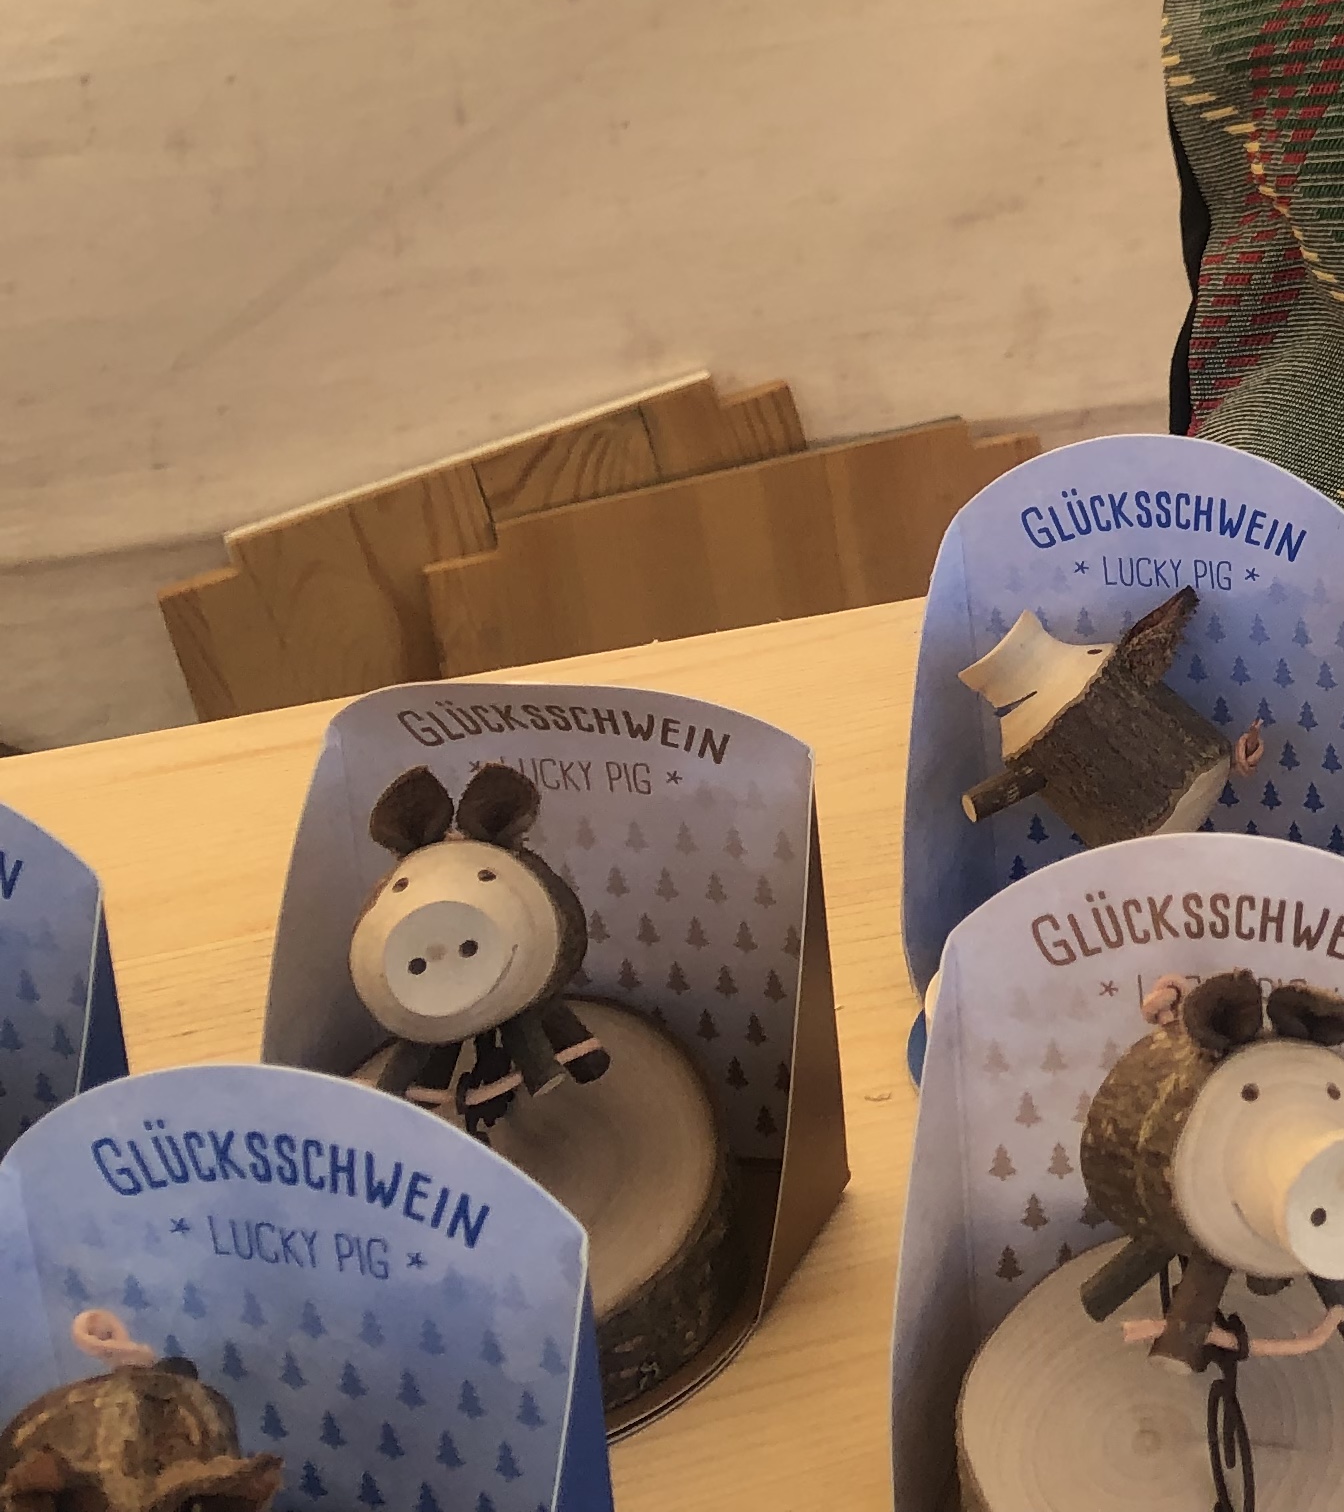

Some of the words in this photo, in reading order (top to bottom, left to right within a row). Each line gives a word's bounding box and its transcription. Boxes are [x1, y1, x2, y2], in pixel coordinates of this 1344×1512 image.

[1019, 487, 1308, 563] GLÜCKSSCHWEIN
[1102, 556, 1183, 589] LUCKY
[1193, 559, 1233, 591] PIG
[397, 699, 732, 765] GLÜCKSSCHWEIN
[605, 761, 652, 795] PIG
[90, 1119, 491, 1249] GLÜCKSSCHWEIN
[207, 1214, 319, 1268] LUCKY
[333, 1231, 391, 1281] PIG
